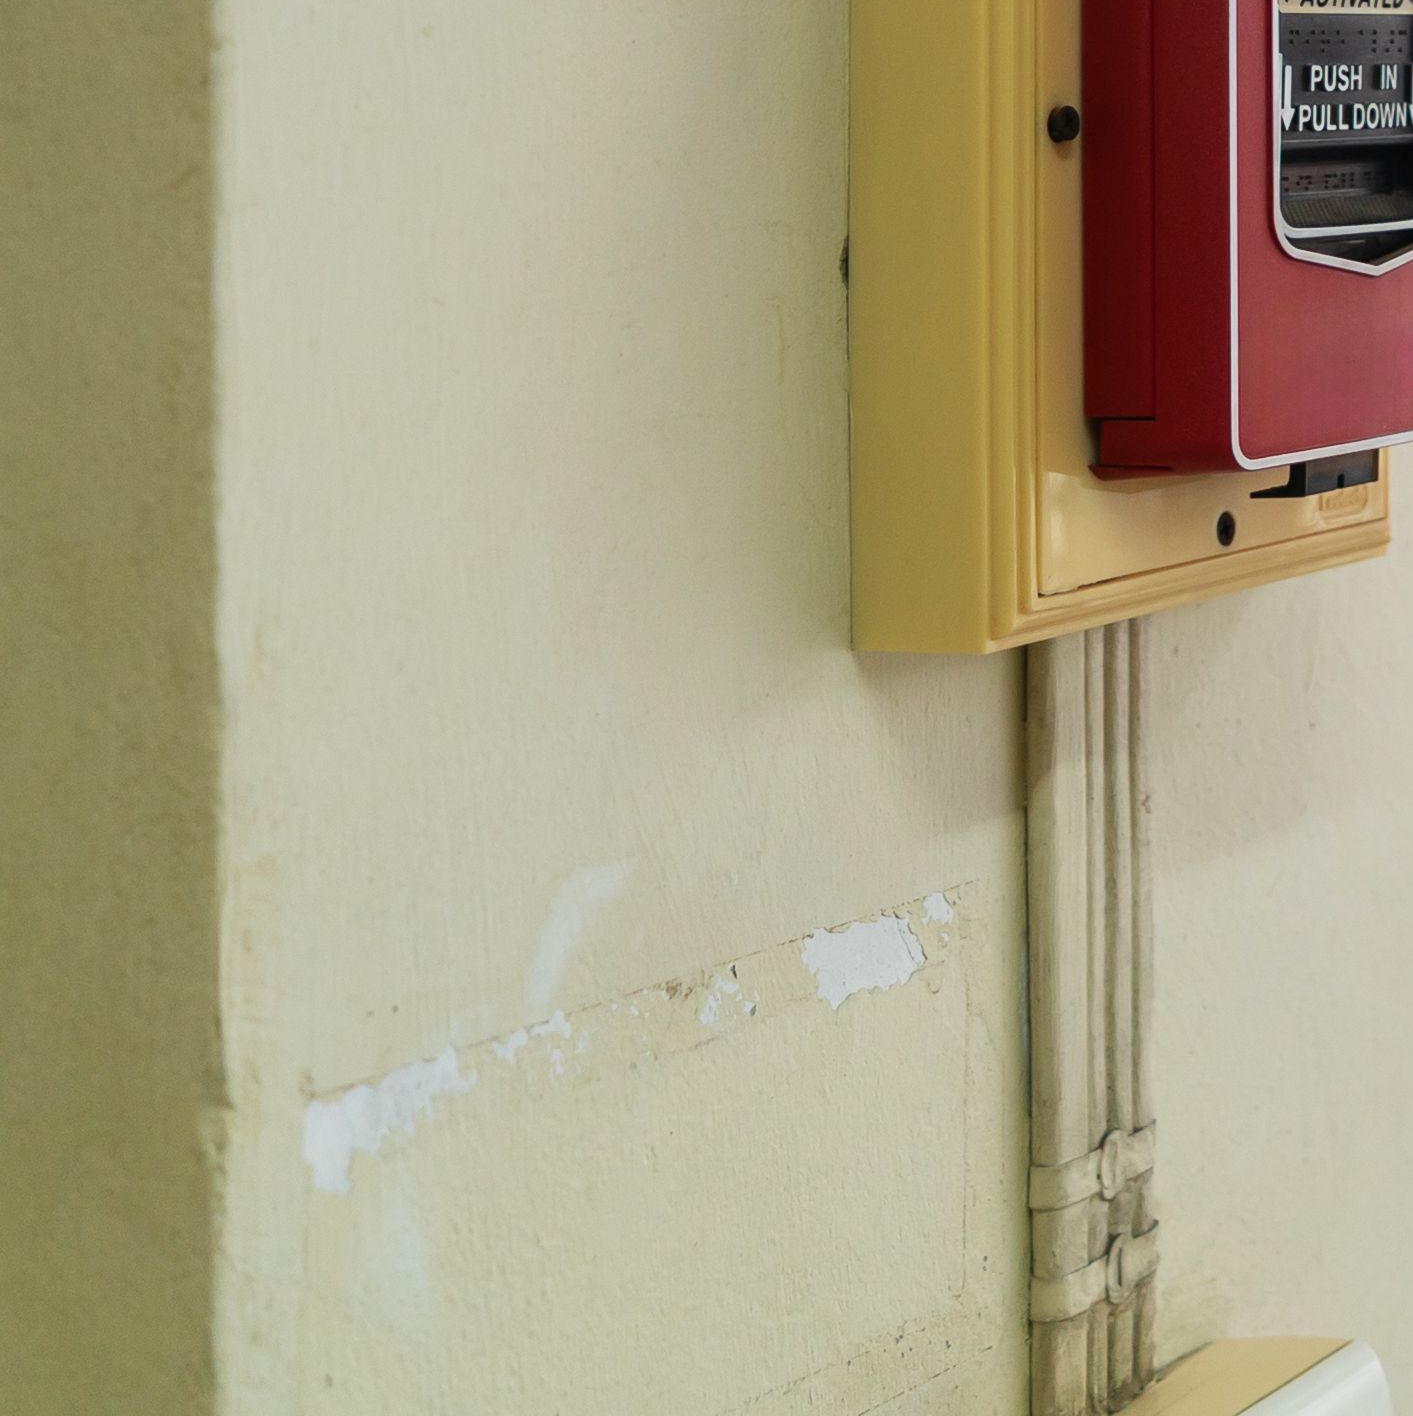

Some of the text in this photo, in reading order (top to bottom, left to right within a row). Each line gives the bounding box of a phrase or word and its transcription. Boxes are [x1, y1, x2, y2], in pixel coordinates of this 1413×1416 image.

[1310, 64, 1397, 92] PUSH IN
[1299, 102, 1407, 132] PULL DOWN
